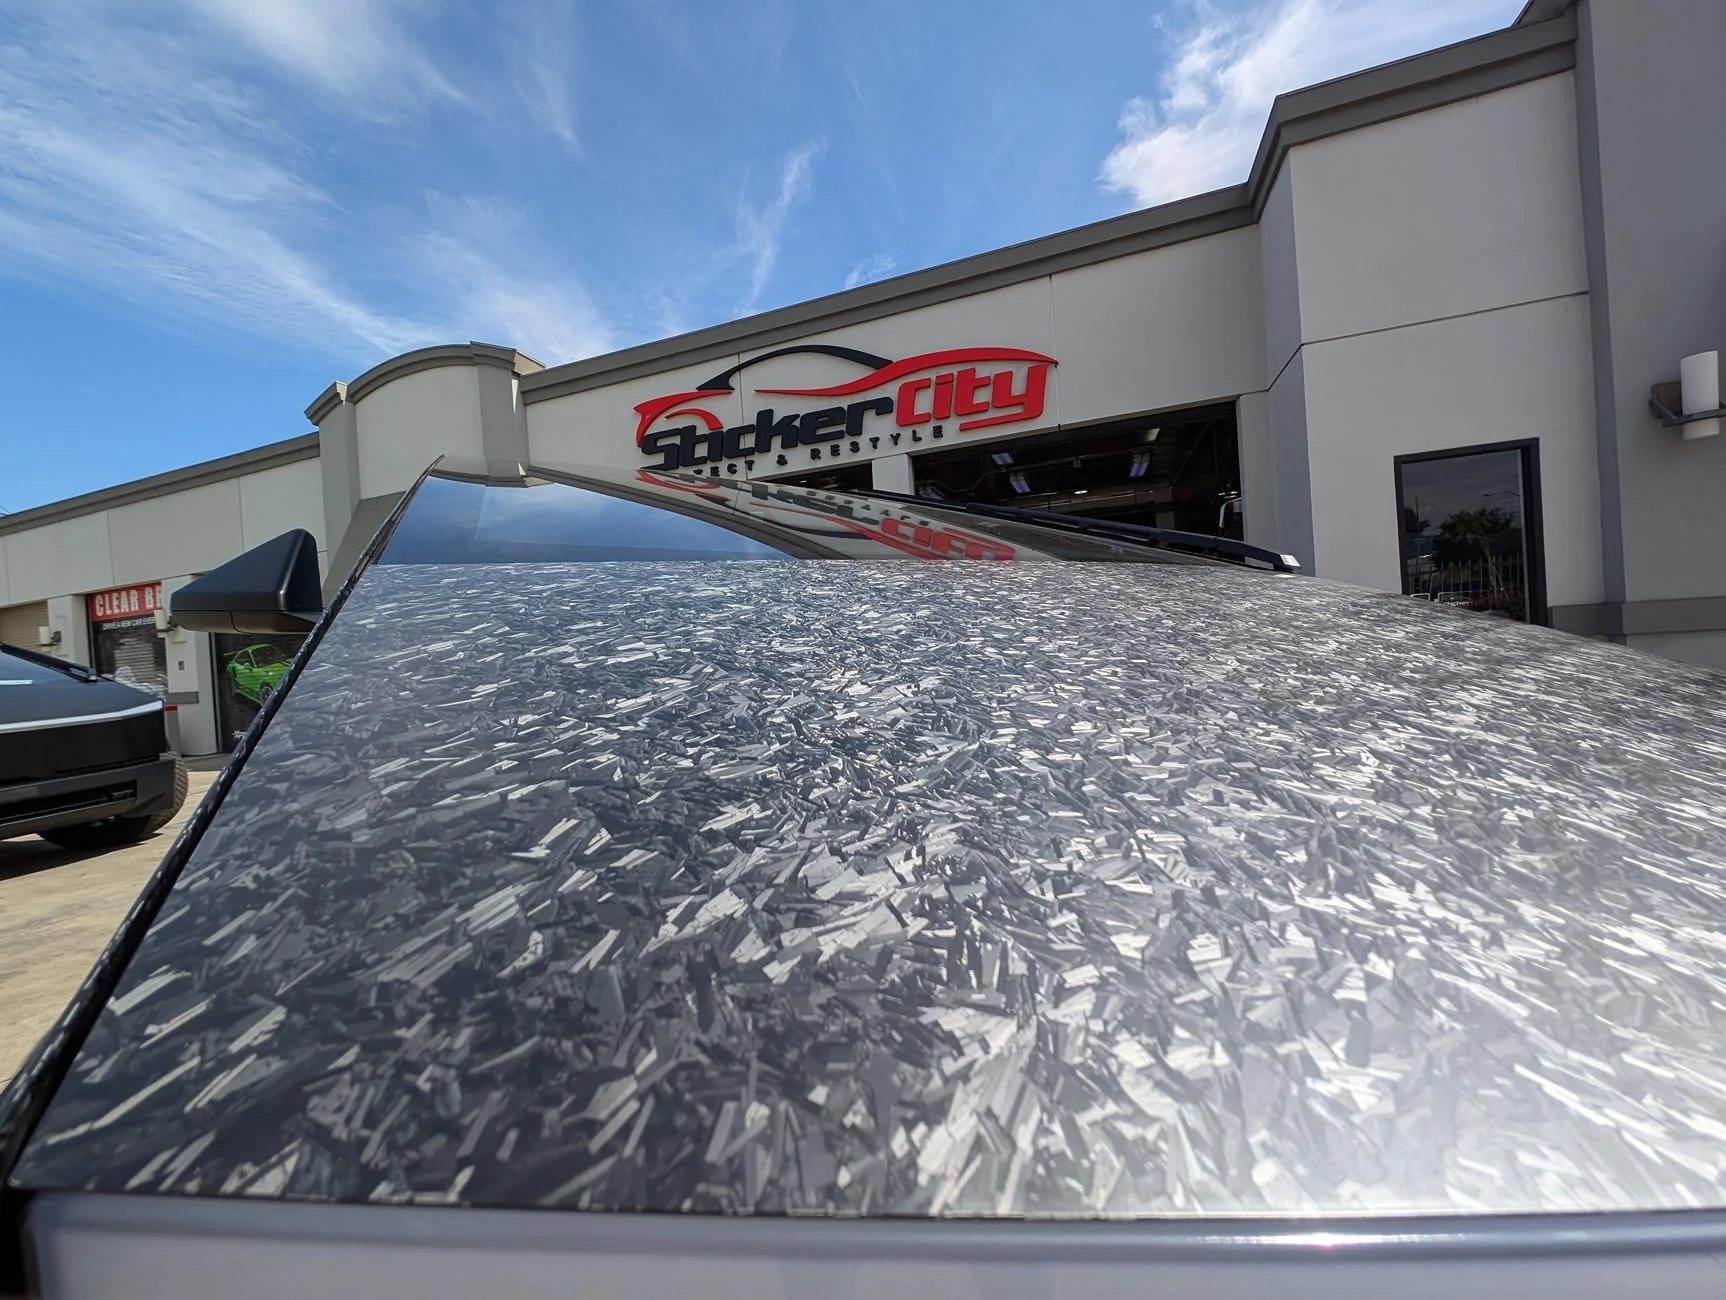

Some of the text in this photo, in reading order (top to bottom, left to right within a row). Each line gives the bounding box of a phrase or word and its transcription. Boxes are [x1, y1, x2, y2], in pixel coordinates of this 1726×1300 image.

[776, 454, 788, 466] &
[810, 425, 944, 460] RESTYLE
[96, 590, 139, 616] CLEAR
